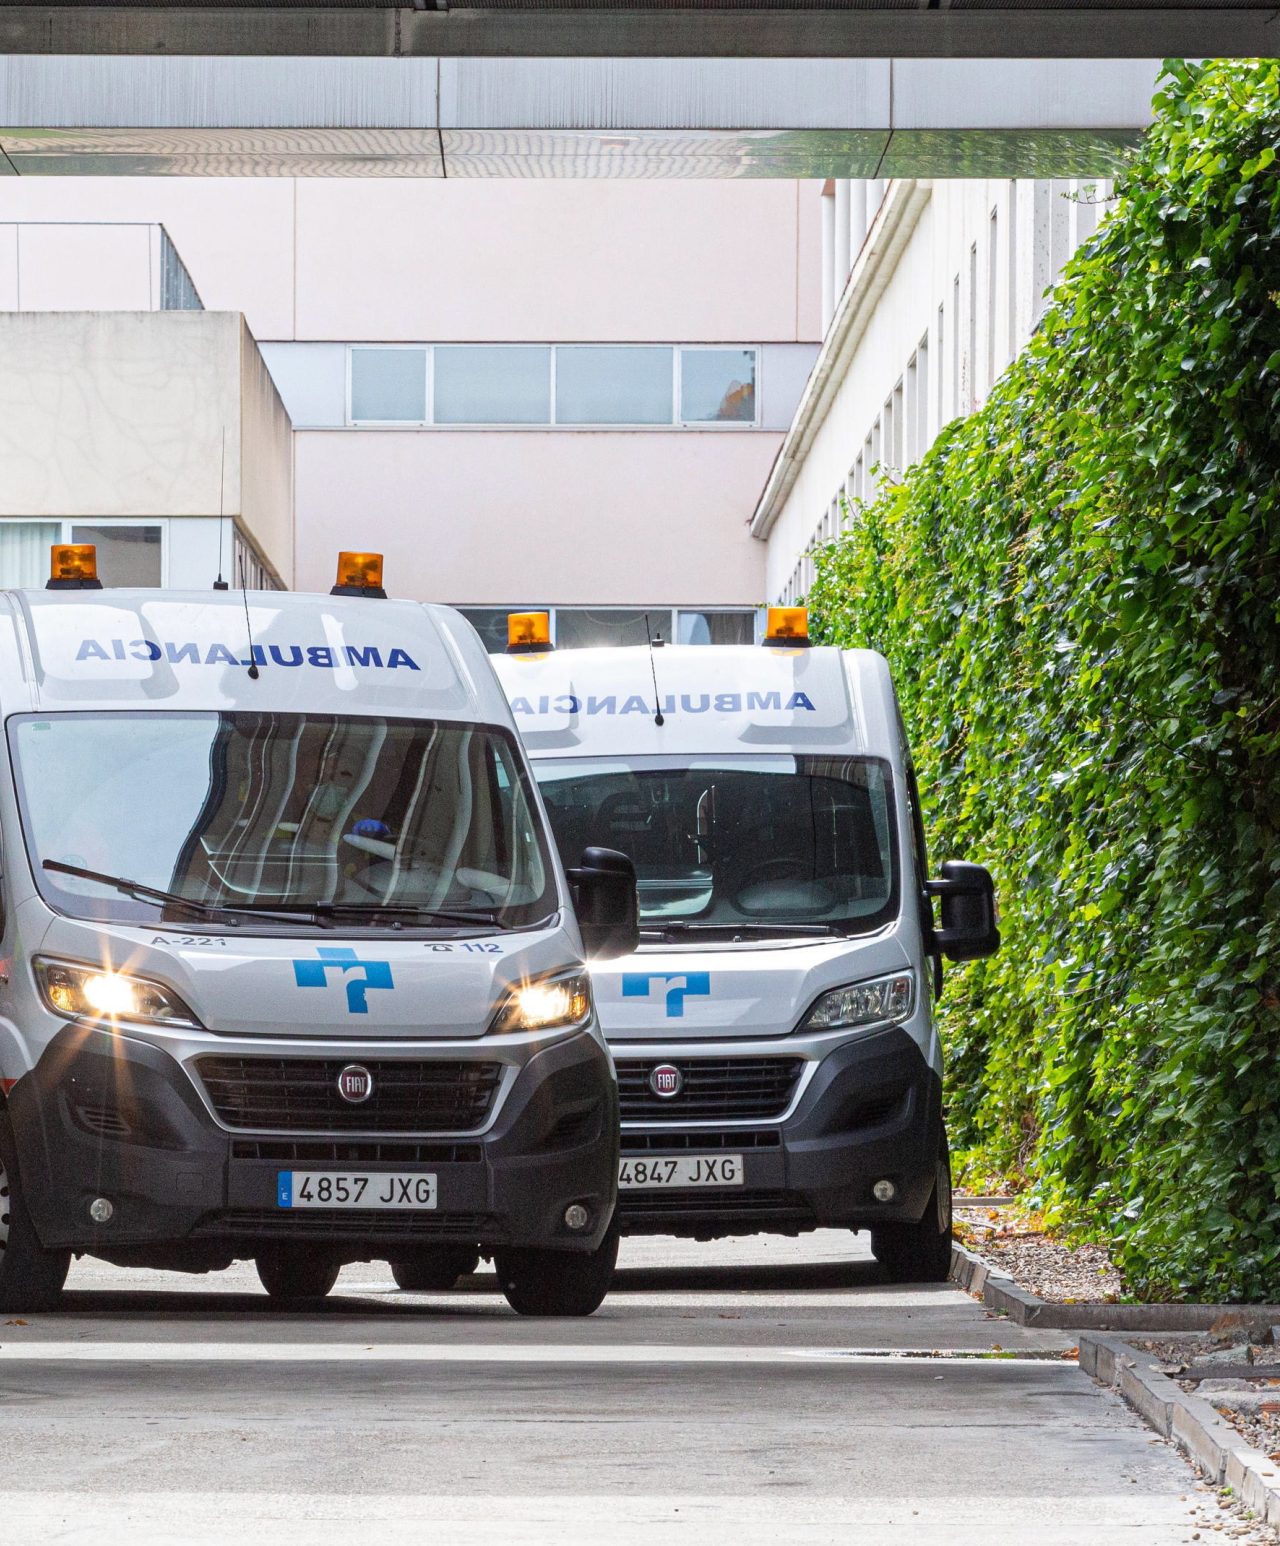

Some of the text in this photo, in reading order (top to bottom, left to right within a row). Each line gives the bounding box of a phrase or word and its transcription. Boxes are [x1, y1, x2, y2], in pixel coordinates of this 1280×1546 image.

[150, 936, 227, 946] A-221
[459, 943, 504, 953] 112
[346, 1076, 367, 1093] FIAT
[657, 1073, 676, 1089] FIAT
[618, 1158, 735, 1185] 4847 JXG
[299, 1176, 370, 1203] 4857
[379, 1177, 431, 1204] JXG
